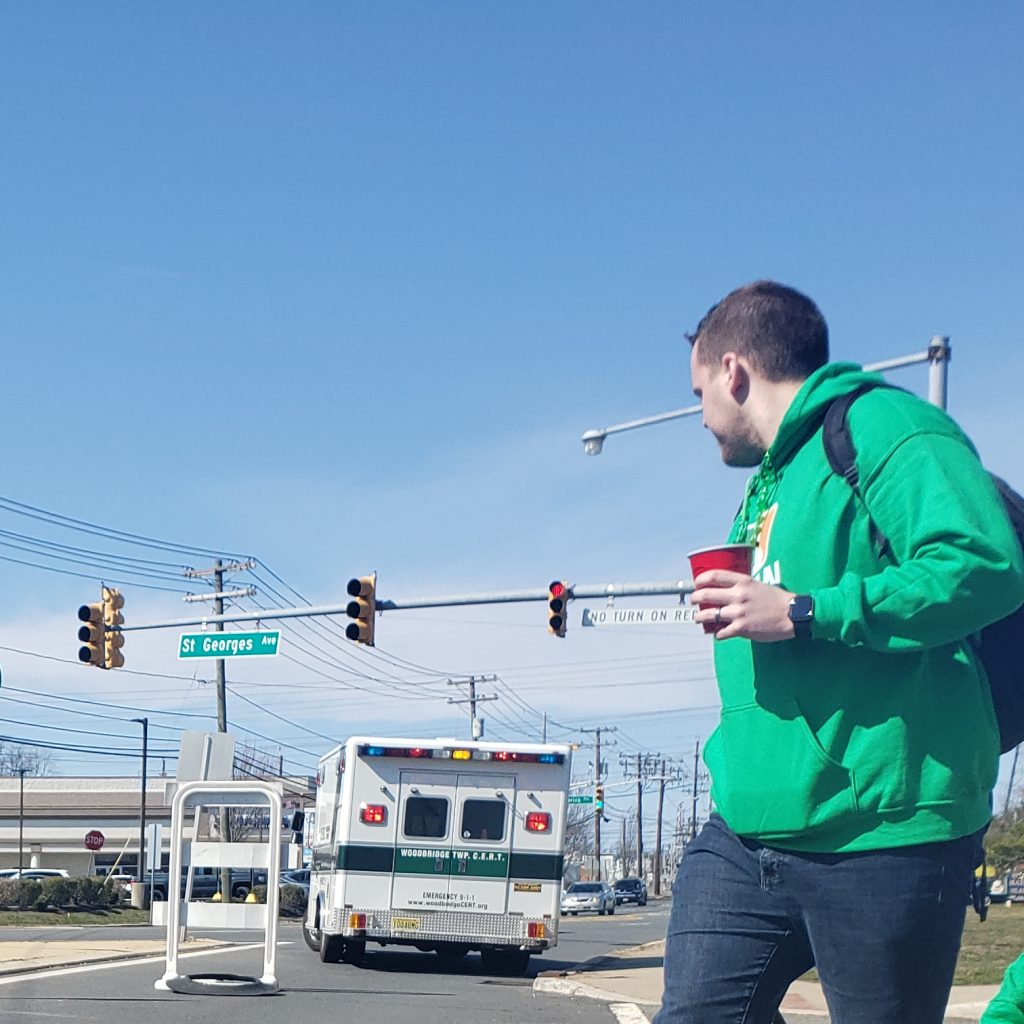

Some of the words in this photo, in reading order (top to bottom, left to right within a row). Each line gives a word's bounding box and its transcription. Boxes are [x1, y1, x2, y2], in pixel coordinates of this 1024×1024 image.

[591, 610, 606, 622] NO
[613, 610, 644, 621] TURN
[650, 610, 667, 620] ON
[182, 638, 196, 652] St
[202, 638, 253, 655] Georges
[261, 635, 277, 646] Ave
[86, 835, 103, 845] STOP
[400, 848, 450, 859] WOODBRIDGE
[422, 892, 458, 901] EMERGENCY
